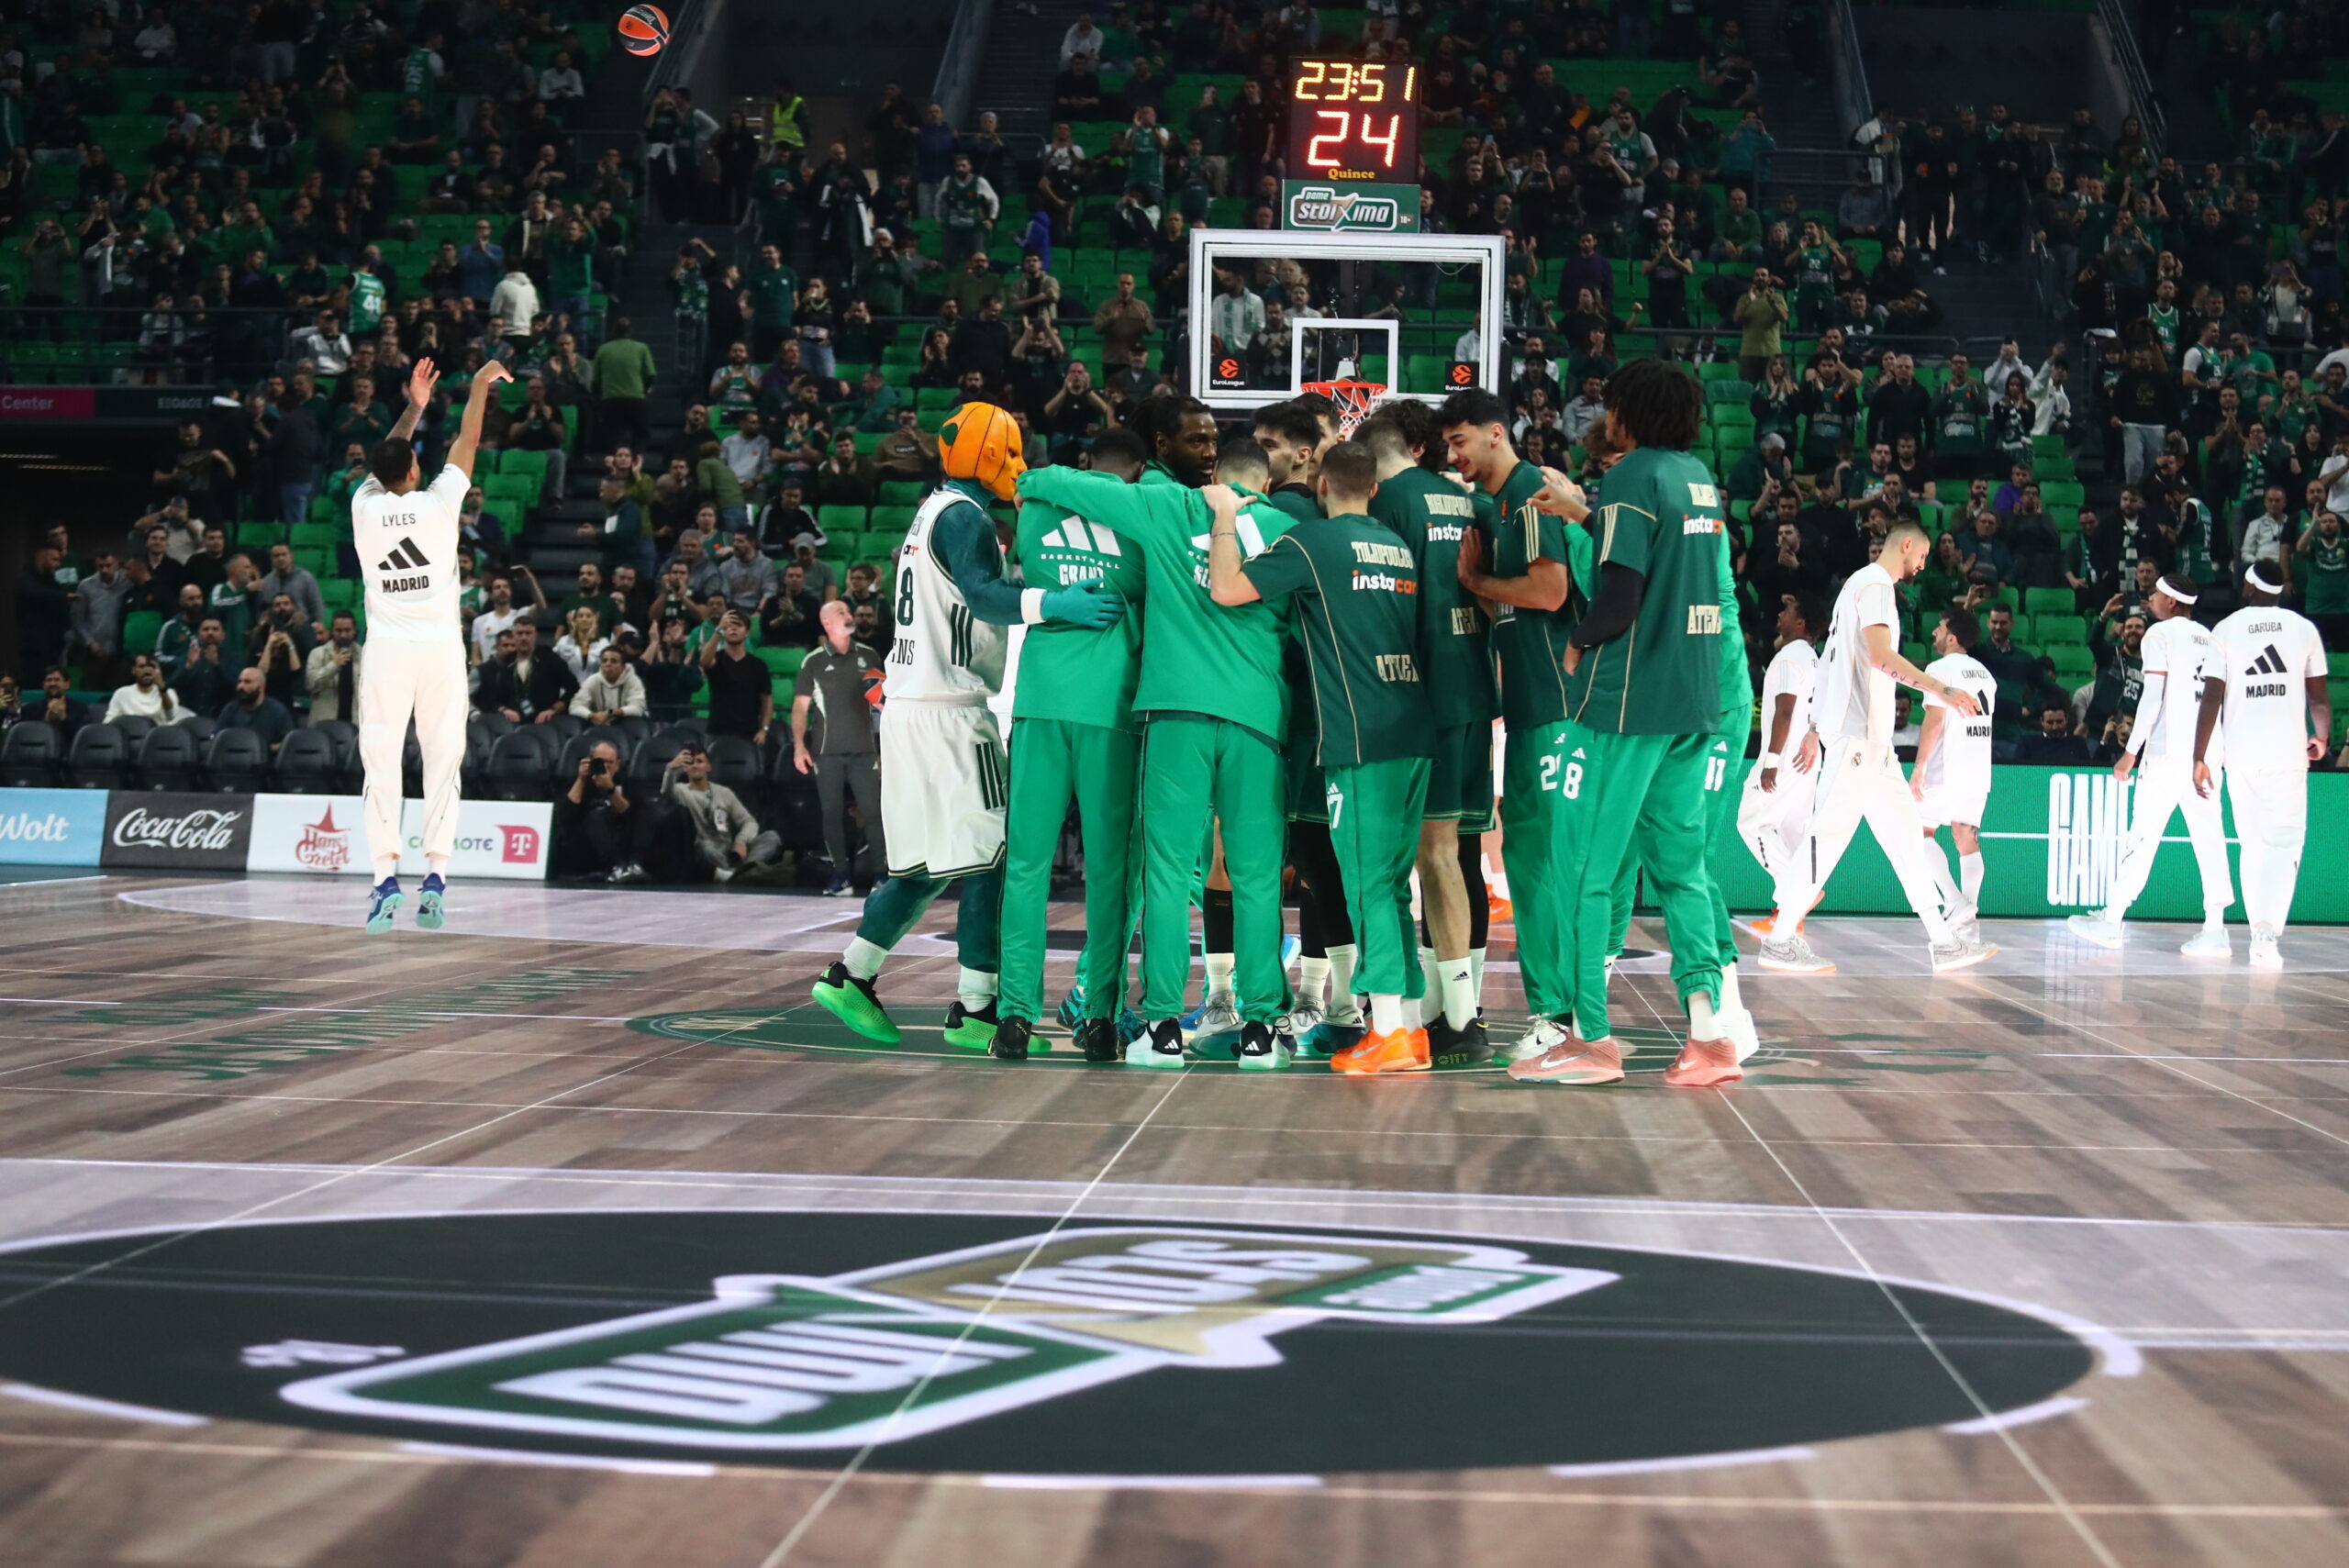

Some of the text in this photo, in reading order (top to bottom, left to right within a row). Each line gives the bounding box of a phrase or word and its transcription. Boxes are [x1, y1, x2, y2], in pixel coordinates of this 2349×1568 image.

[1295, 61, 1416, 102] 23:51
[1307, 110, 1400, 167] 24
[1328, 168, 1375, 180] Quince
[1212, 379, 1245, 387] EuroLeague
[2, 395, 54, 410] Center
[382, 513, 417, 528] LYLES
[1427, 522, 1464, 541] insta
[382, 575, 429, 594] MADRID
[2248, 621, 2283, 634] GARUBA
[2245, 684, 2286, 698] MADRID
[1563, 762, 1583, 800] 8
[1704, 756, 1726, 792] 11
[0, 812, 70, 841] Wolt
[303, 827, 347, 854] Hans
[511, 833, 532, 856] T
[295, 840, 351, 867] Gretel
[1438, 1052, 1468, 1065] CITY
